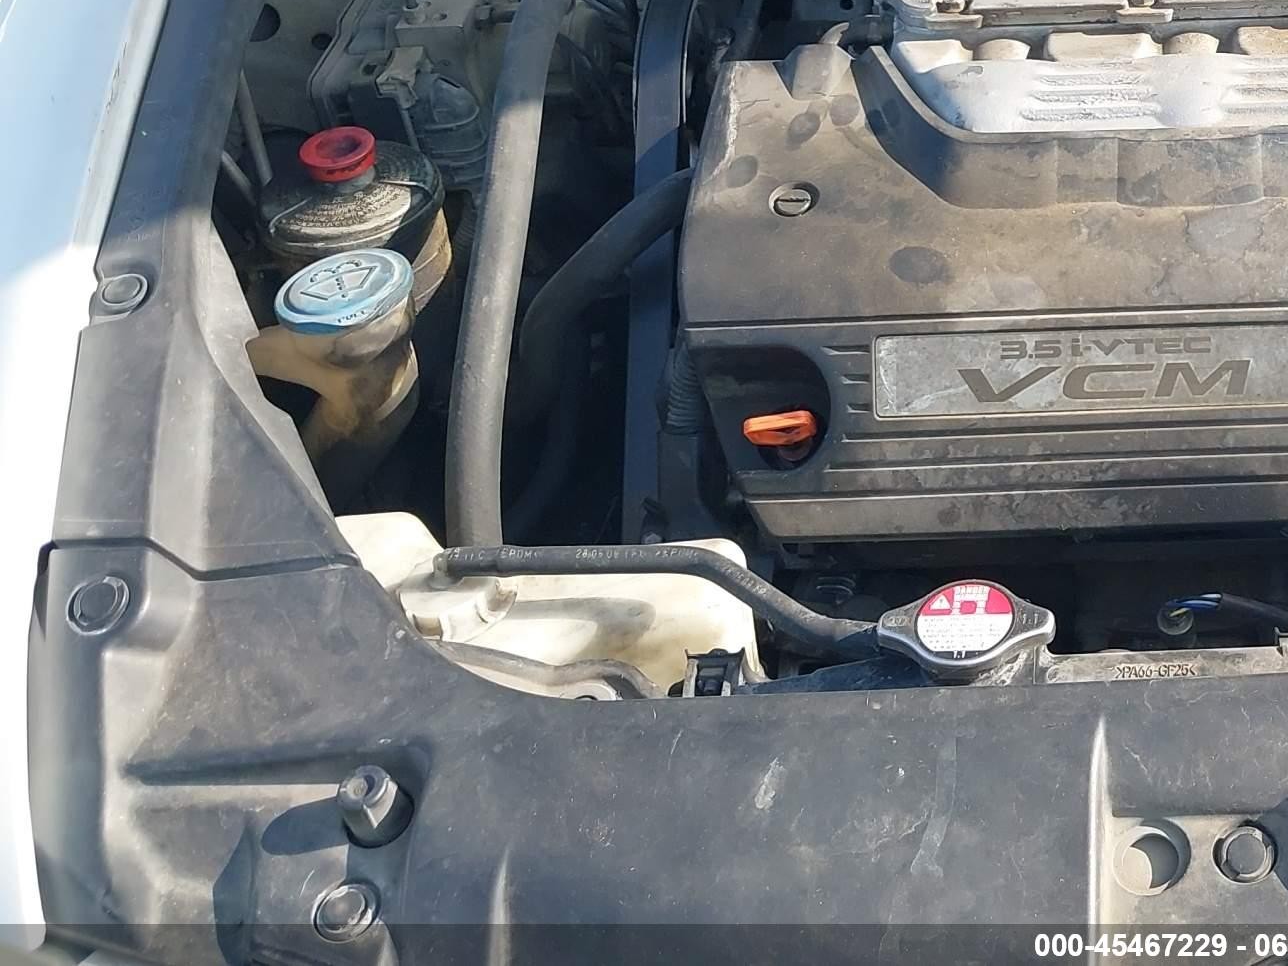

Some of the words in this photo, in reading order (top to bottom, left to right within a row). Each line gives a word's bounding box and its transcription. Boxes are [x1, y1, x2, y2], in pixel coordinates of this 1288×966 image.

[1000, 337, 1062, 360] 3.5
[1070, 336, 1212, 358] i-VTEC
[956, 359, 1253, 403] VCM
